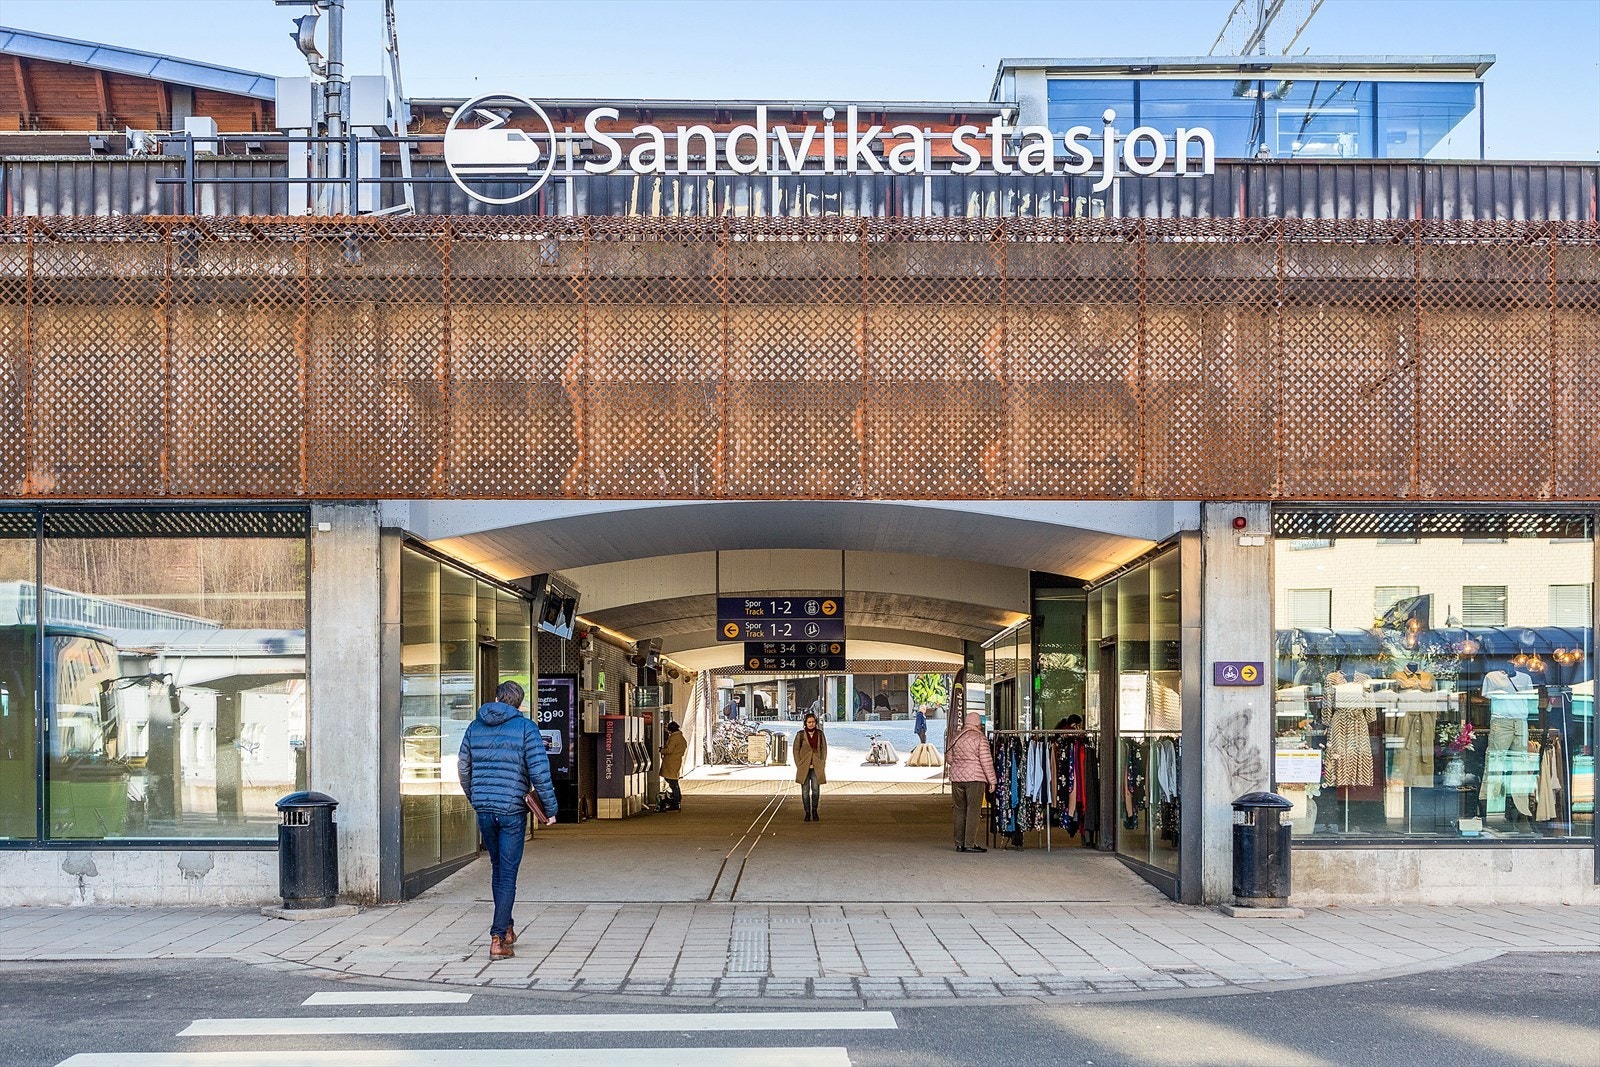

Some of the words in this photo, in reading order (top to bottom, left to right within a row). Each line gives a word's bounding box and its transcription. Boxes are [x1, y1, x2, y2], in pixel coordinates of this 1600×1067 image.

[583, 105, 927, 174] Sandvika
[950, 109, 1215, 193] stasjon
[745, 600, 762, 608] Spor
[770, 601, 792, 614] 1-2
[745, 608, 764, 616] Track
[745, 622, 762, 630] Spor
[770, 623, 792, 636] 1-2
[745, 630, 764, 638] Track
[780, 643, 796, 654] 3-4
[780, 659, 796, 669] 3-4
[605, 721, 613, 752] Billetter
[605, 753, 613, 779] Tickets
